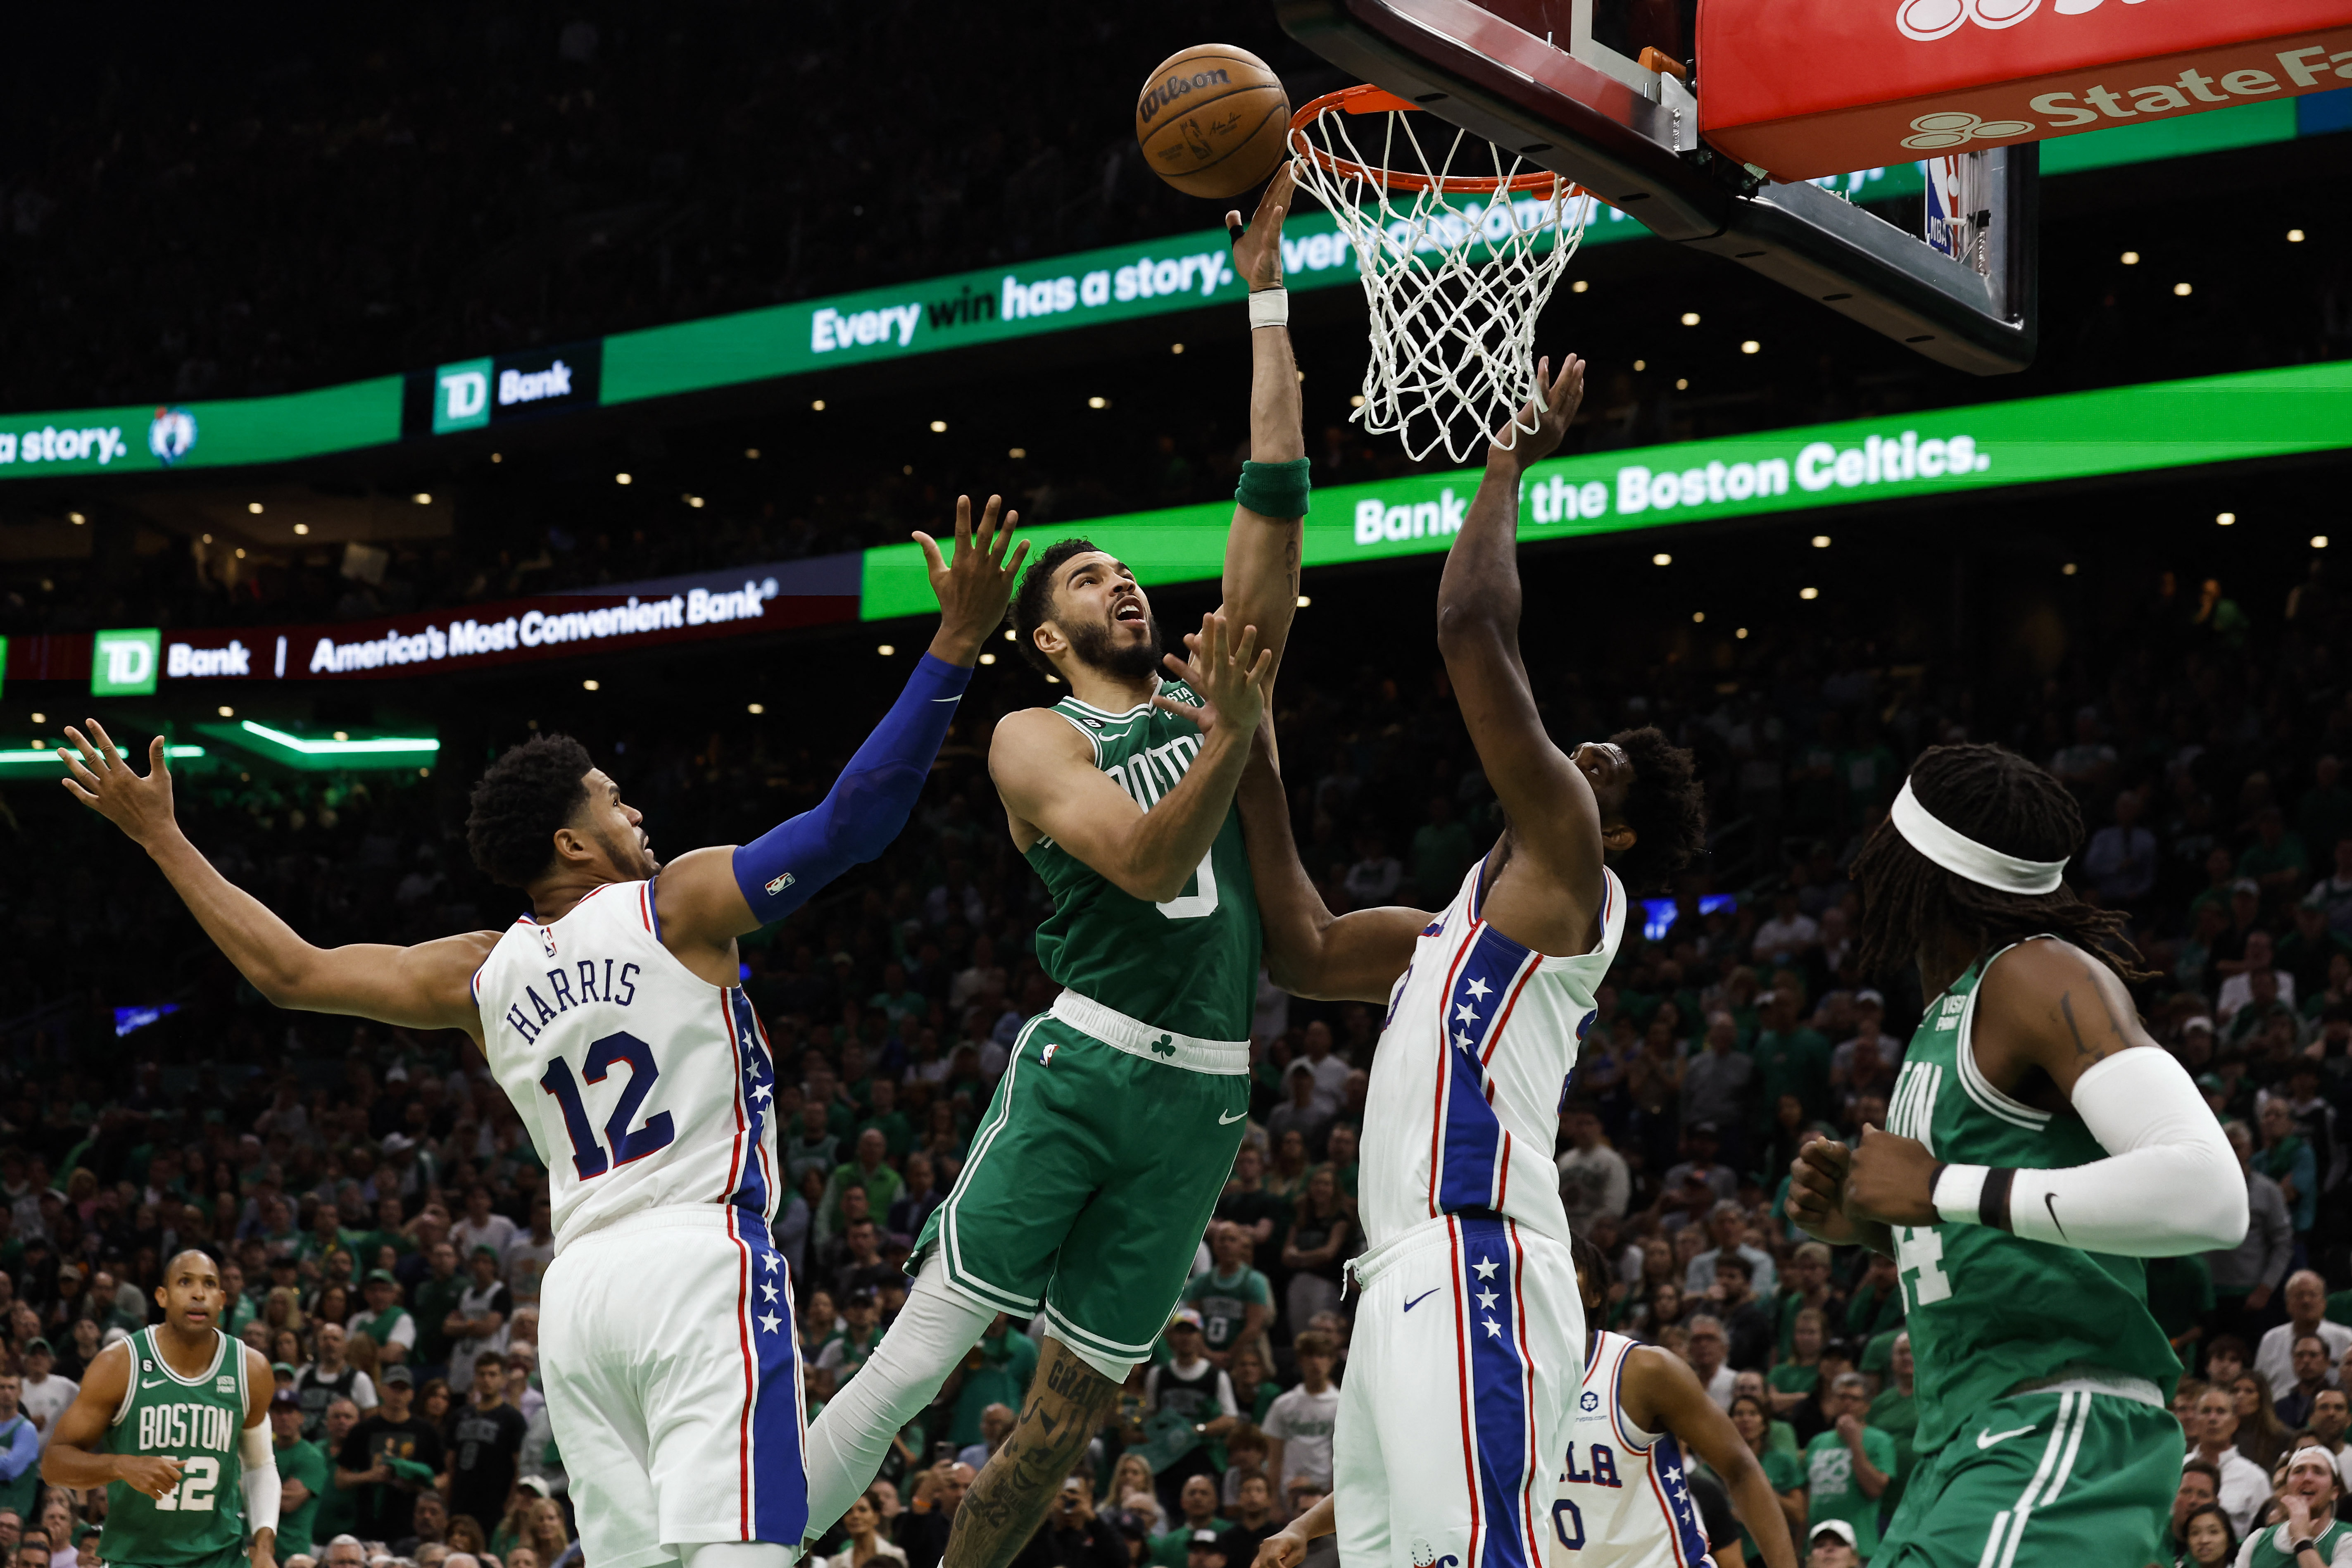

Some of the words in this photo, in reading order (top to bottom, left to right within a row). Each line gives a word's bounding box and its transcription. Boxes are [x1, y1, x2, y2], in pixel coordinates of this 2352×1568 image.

[1139, 69, 1231, 123] Wilson
[2030, 68, 2282, 127] State
[1931, 216, 1947, 247] NBA
[811, 302, 922, 354] Every
[927, 285, 997, 332] win
[1001, 275, 1077, 321] has
[1080, 270, 1111, 307] a
[1114, 250, 1233, 301] story.
[440, 371, 487, 419] TD
[498, 359, 573, 406] Bank
[21, 424, 127, 466] story.
[1354, 488, 1467, 545] Bank
[1531, 475, 1608, 524] the
[1616, 458, 1790, 514] Boston
[1795, 430, 1992, 491] Celtics.
[309, 625, 447, 673] America's
[448, 616, 519, 657] Most
[519, 594, 685, 647] Convenient
[100, 640, 152, 685] TD
[167, 639, 251, 678] Bank
[507, 959, 641, 1045] HARRIS
[540, 1030, 675, 1182] 12
[143, 1359, 153, 1373] 6
[139, 1403, 233, 1453] BOSTON
[1560, 1441, 1622, 1488] LA
